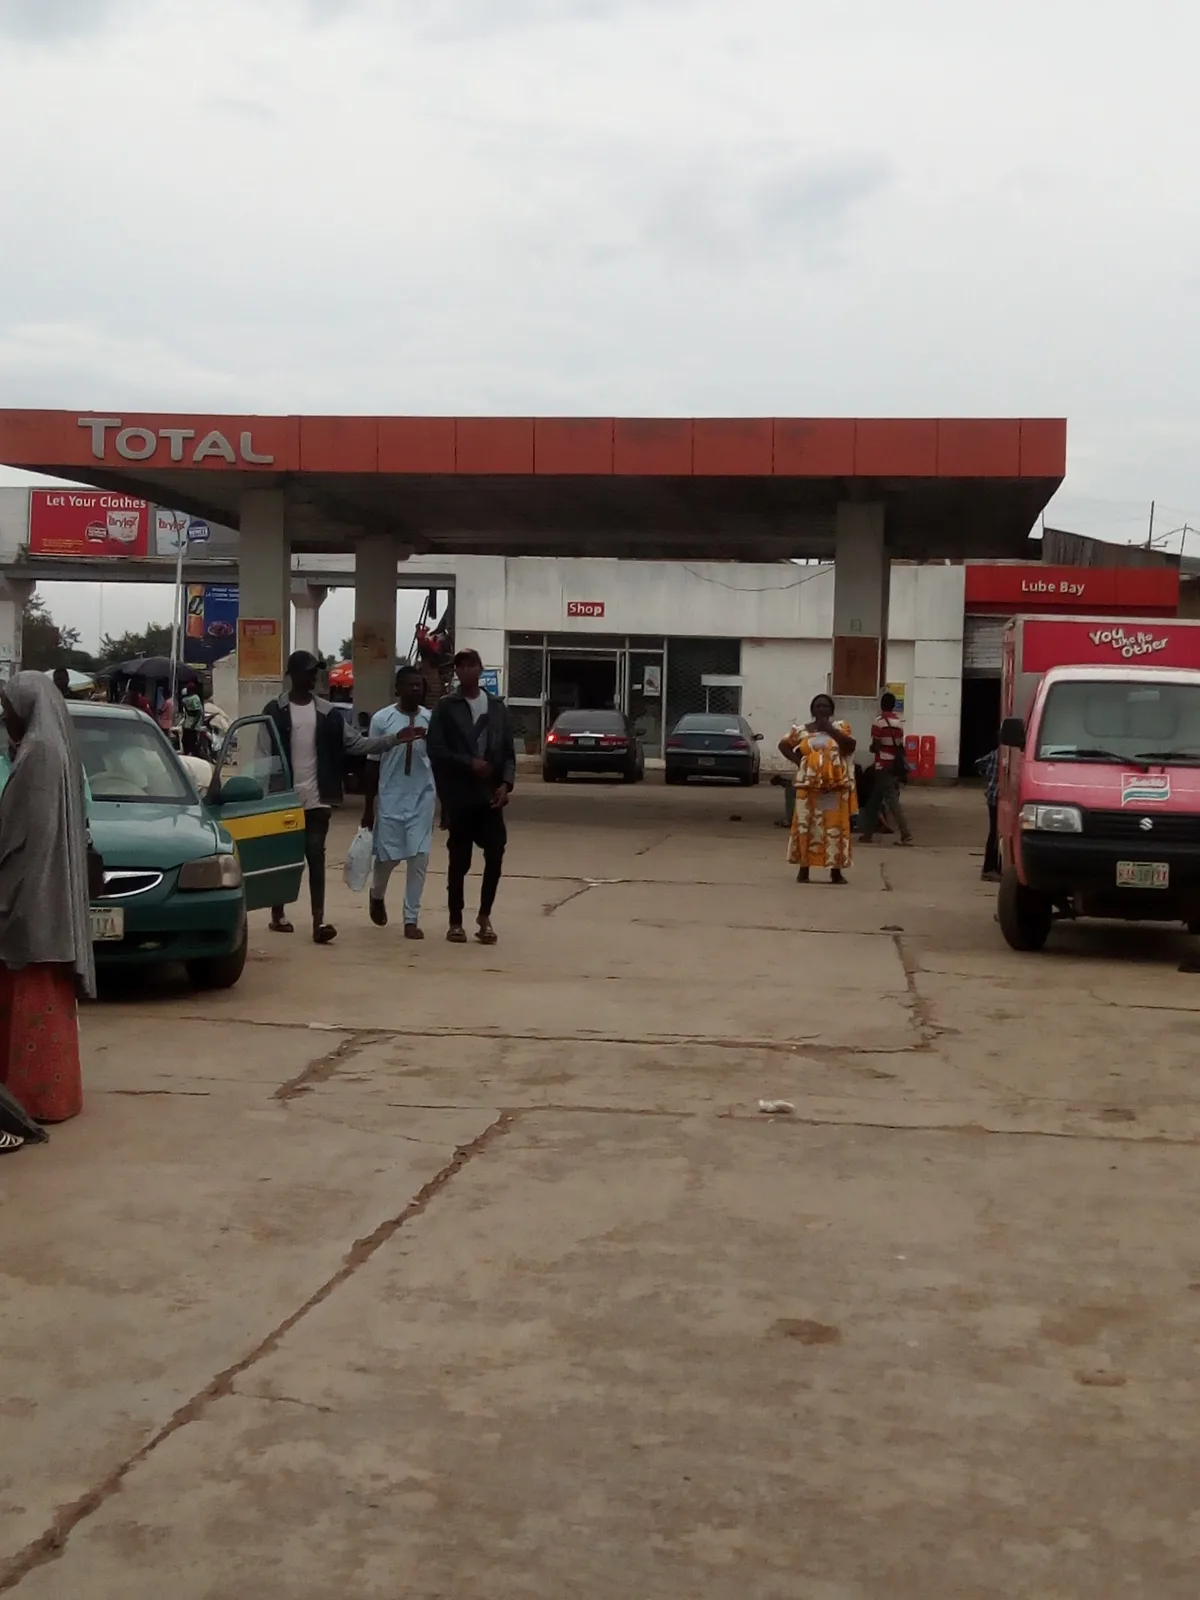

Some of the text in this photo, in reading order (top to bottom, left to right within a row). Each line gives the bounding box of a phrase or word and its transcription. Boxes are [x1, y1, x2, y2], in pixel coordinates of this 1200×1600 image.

[77, 417, 275, 465] TOTAL
[46, 494, 147, 509] Let Your Clothes
[1021, 579, 1085, 596] Lube Bay
[569, 602, 602, 616] Shop
[1121, 638, 1169, 658] Other
